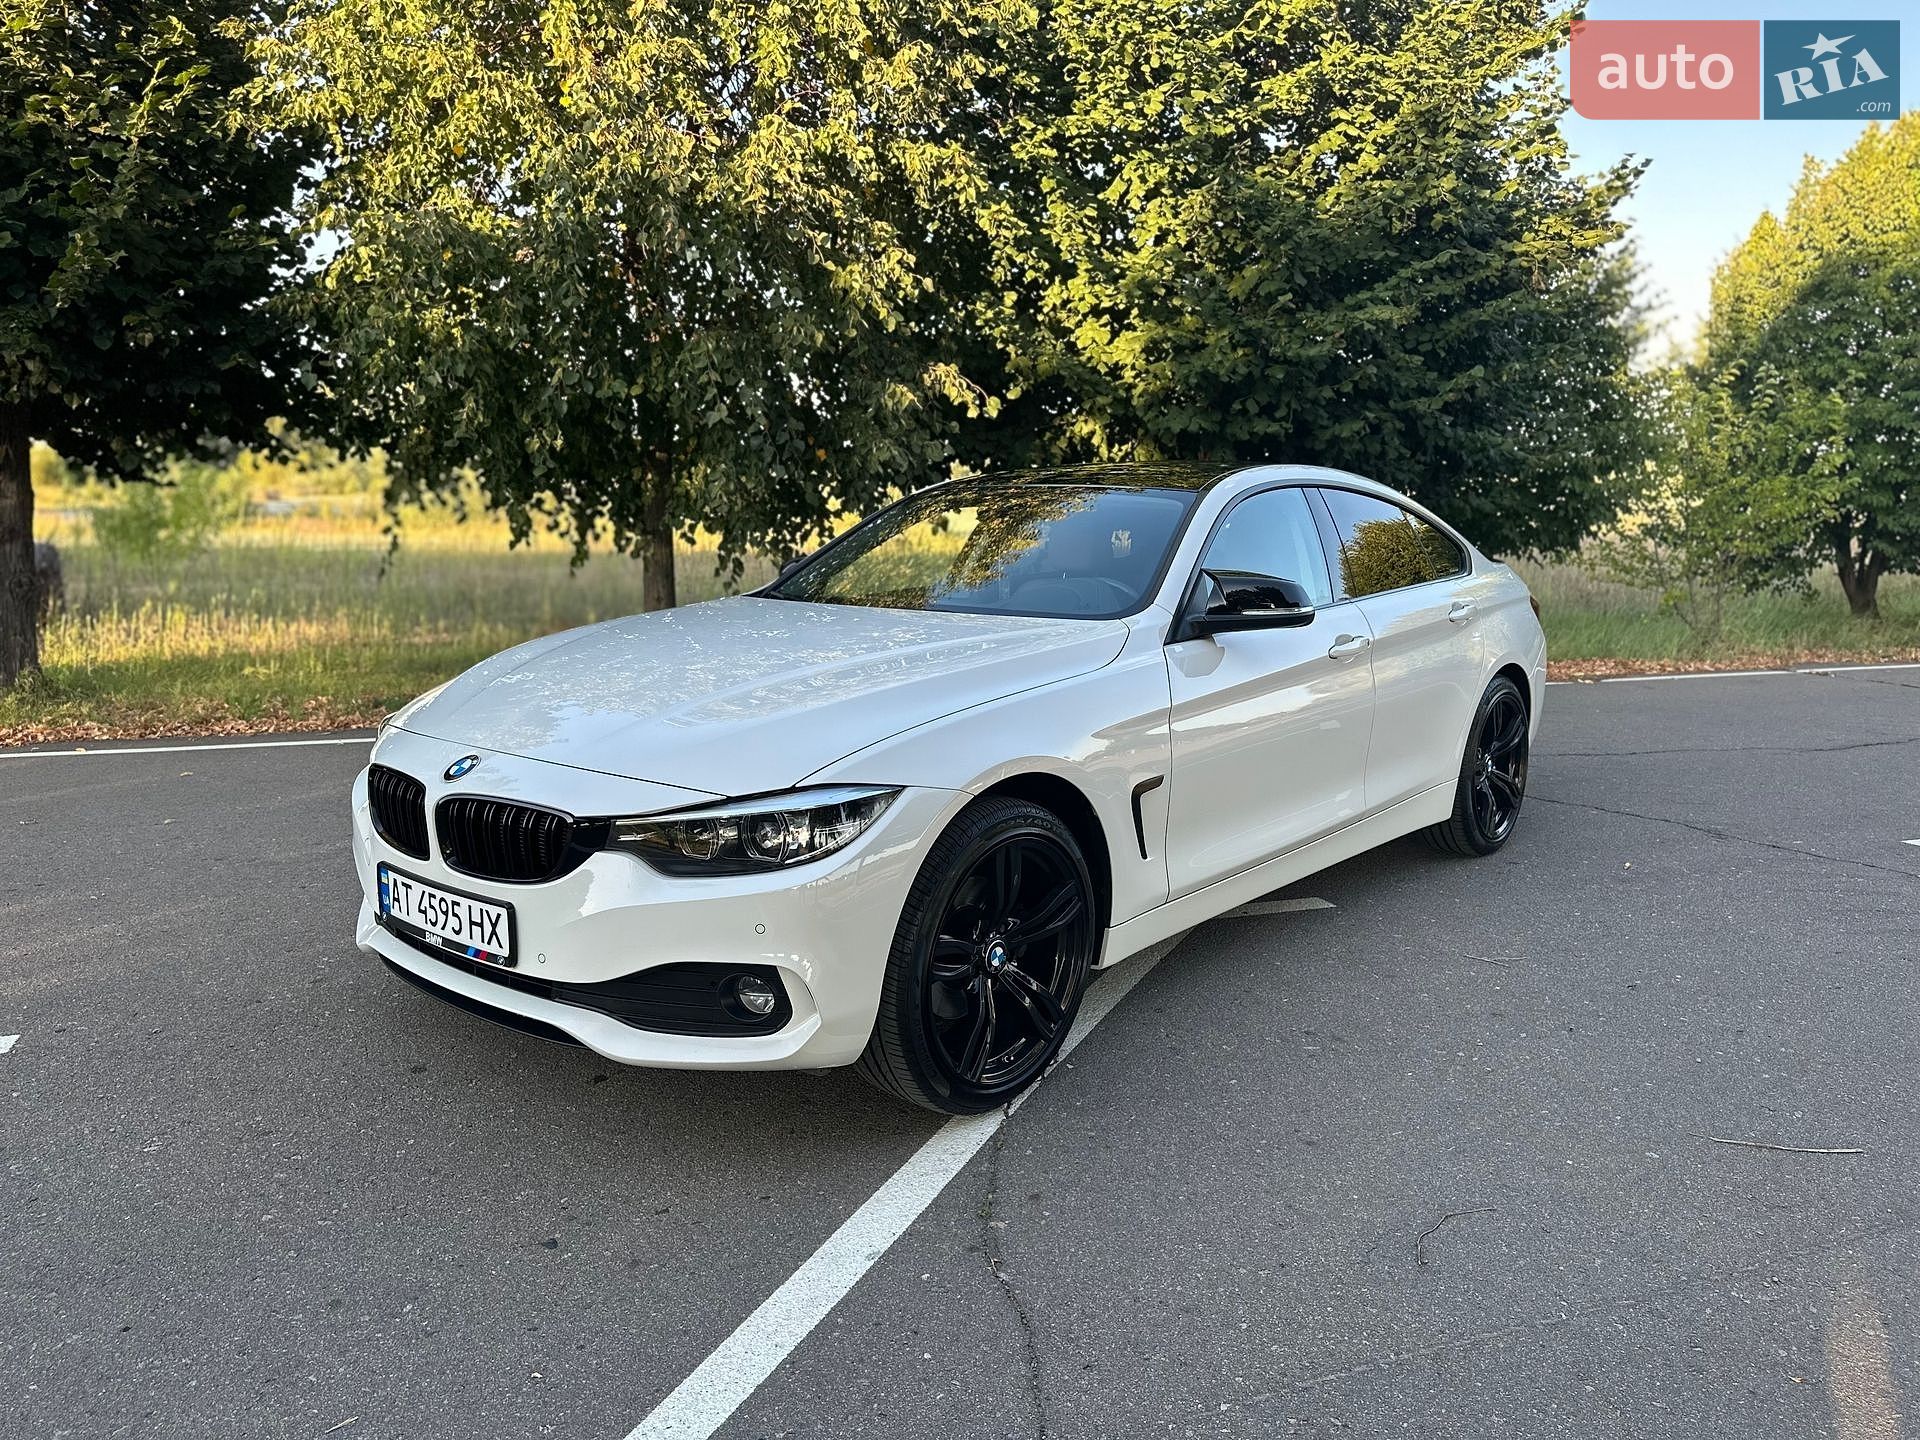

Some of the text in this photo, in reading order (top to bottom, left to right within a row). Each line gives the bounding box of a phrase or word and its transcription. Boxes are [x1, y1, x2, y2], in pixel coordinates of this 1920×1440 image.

[392, 877, 504, 949] AT 4595 HX
[425, 931, 443, 947] BMW
